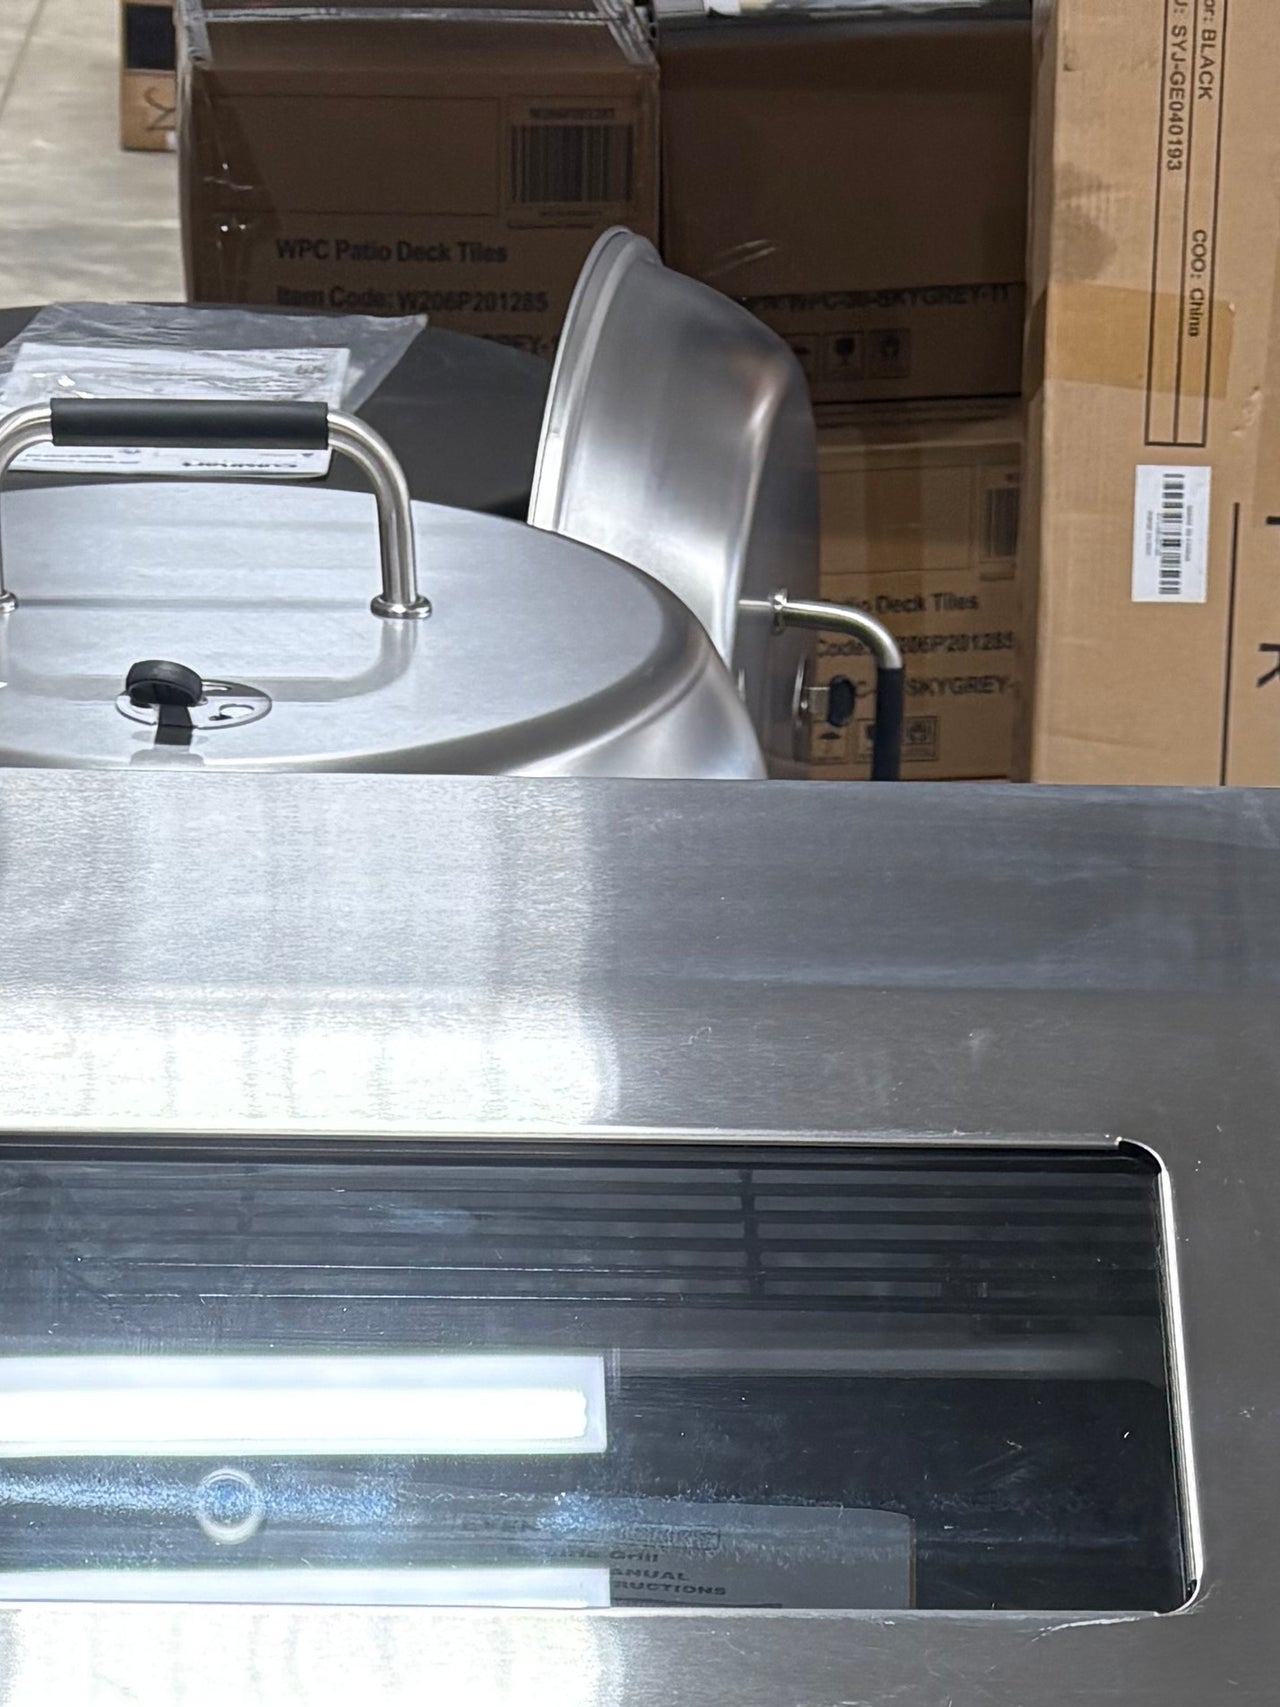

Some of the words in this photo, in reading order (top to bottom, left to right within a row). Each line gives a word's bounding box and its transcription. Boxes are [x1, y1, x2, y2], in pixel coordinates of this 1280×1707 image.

[1197, 28, 1217, 100] BLACK
[1166, 24, 1188, 171] SYJ-GE040193
[276, 239, 329, 260] WPC
[336, 240, 391, 262] Patio
[397, 241, 451, 262] Deck
[457, 241, 508, 263] Tiles
[1190, 229, 1208, 278] COO:
[1188, 287, 1205, 337] China
[875, 595, 926, 613] Deck
[931, 592, 979, 611] Tiles
